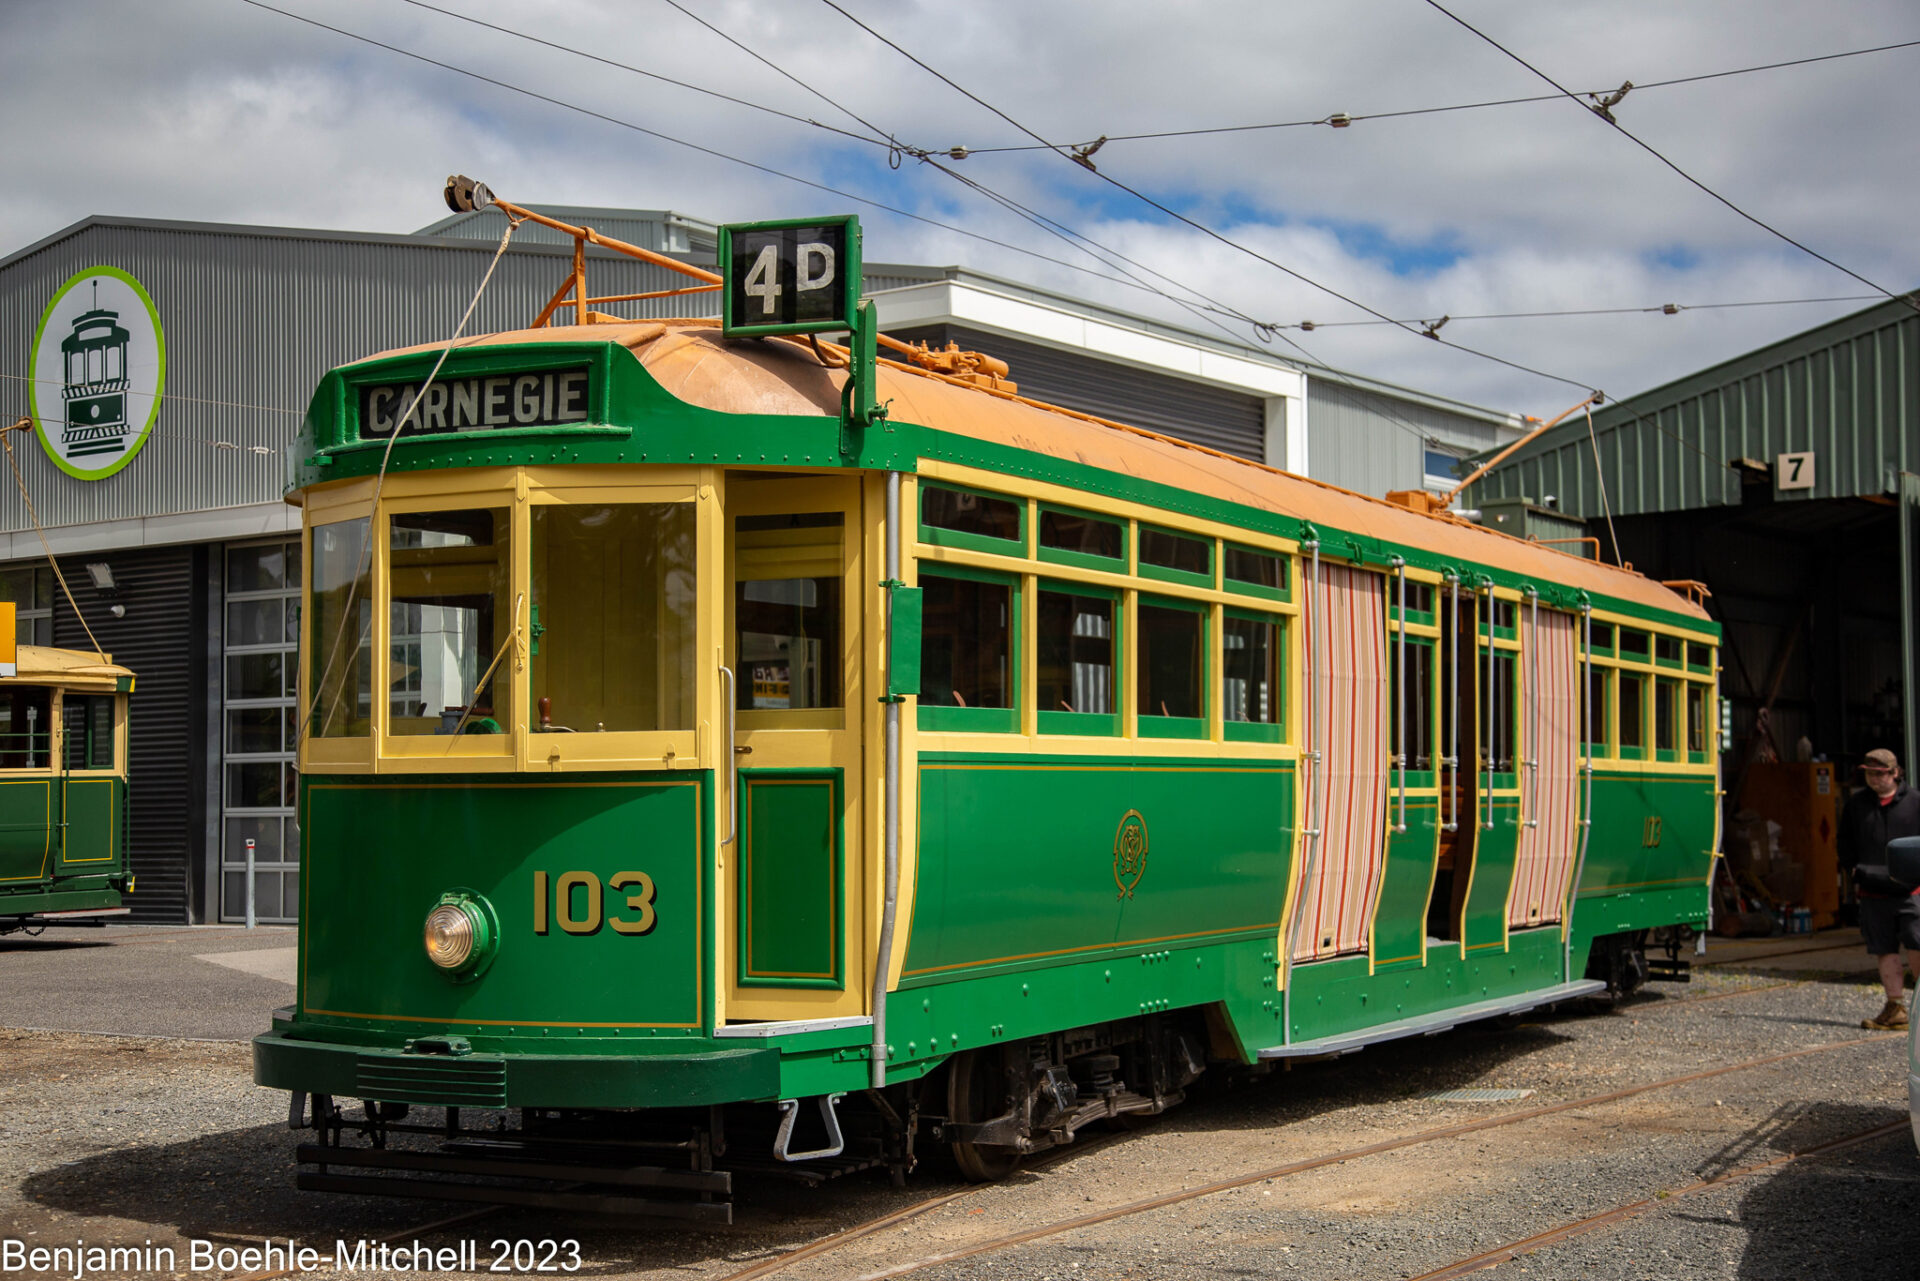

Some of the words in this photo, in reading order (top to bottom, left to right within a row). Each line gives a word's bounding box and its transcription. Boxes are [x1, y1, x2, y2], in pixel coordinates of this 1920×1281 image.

[368, 372, 588, 432] CARNEGIE
[1788, 457, 1805, 482] 7
[1642, 815, 1662, 848] 103
[534, 870, 658, 936] 103
